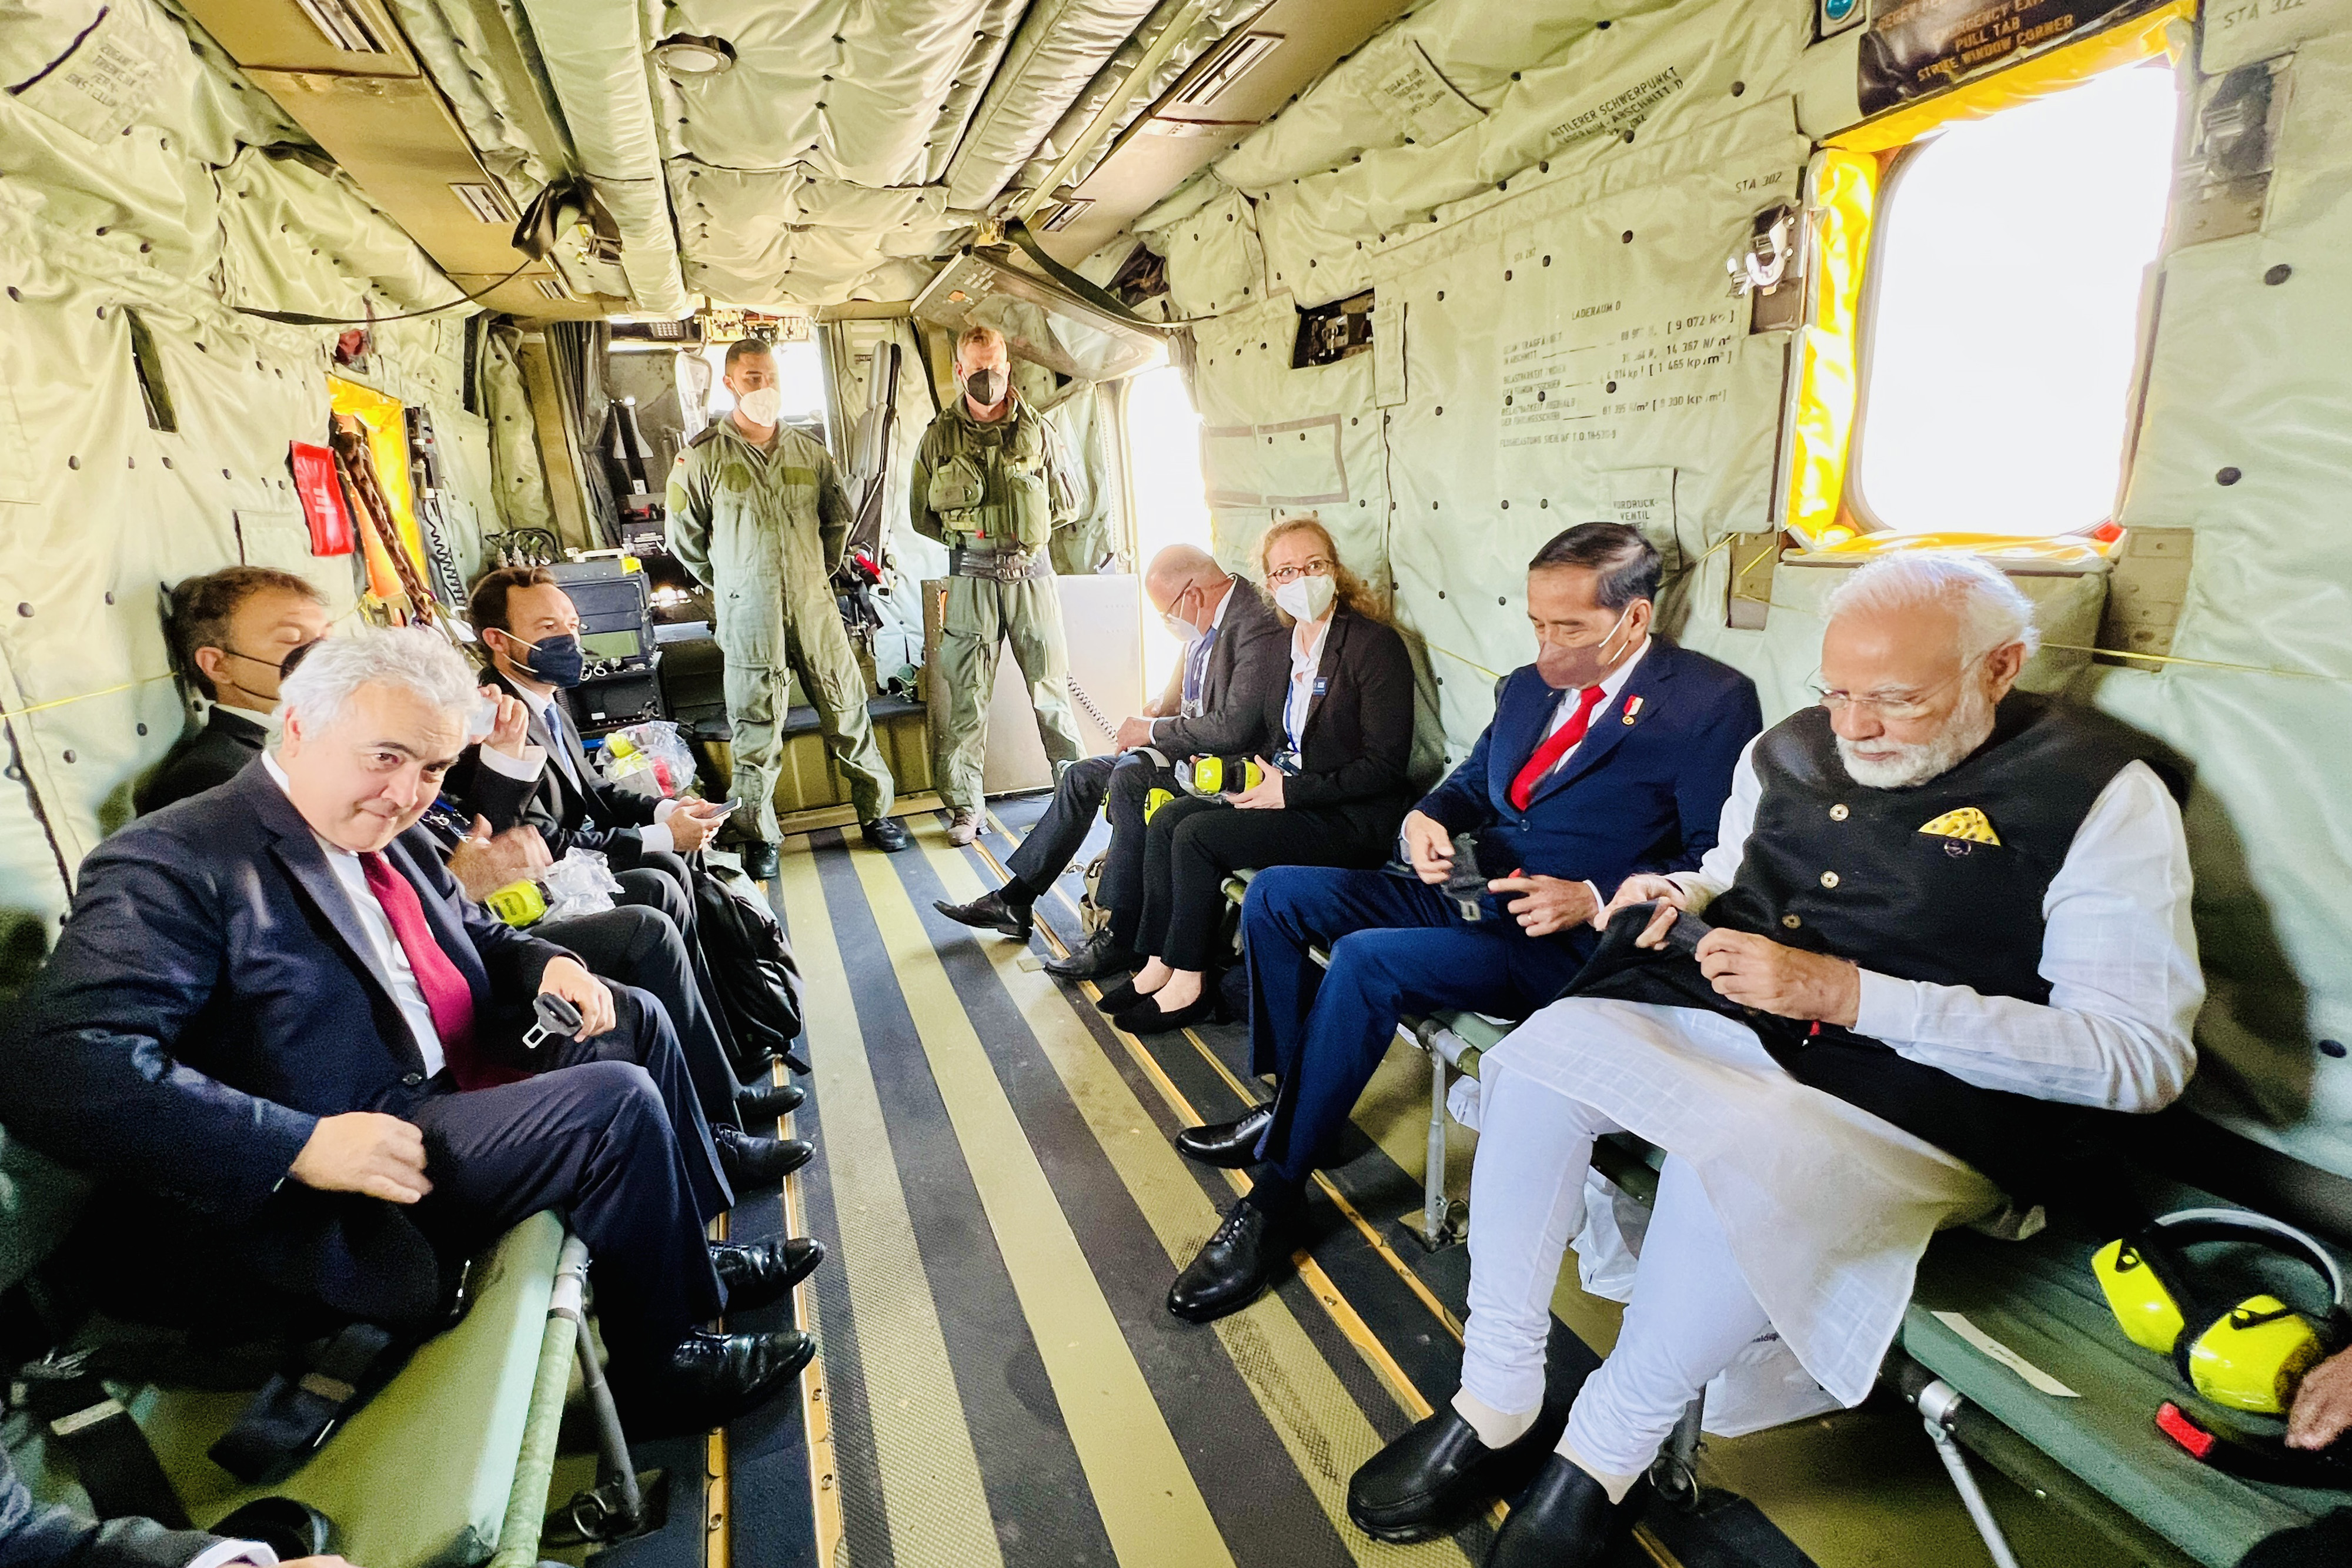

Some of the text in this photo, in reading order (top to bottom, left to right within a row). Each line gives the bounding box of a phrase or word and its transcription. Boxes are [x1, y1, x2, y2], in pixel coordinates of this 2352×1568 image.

[2224, 4, 2259, 29] STA
[1955, 16, 2020, 52] PULL TAB
[1917, 58, 1959, 82] STRIKE
[1598, 66, 1678, 115] SCHWERPUNKT
[1735, 178, 1756, 193] STA
[1572, 303, 1613, 320] LADERAUM
[1621, 510, 1650, 521] VENTIL
